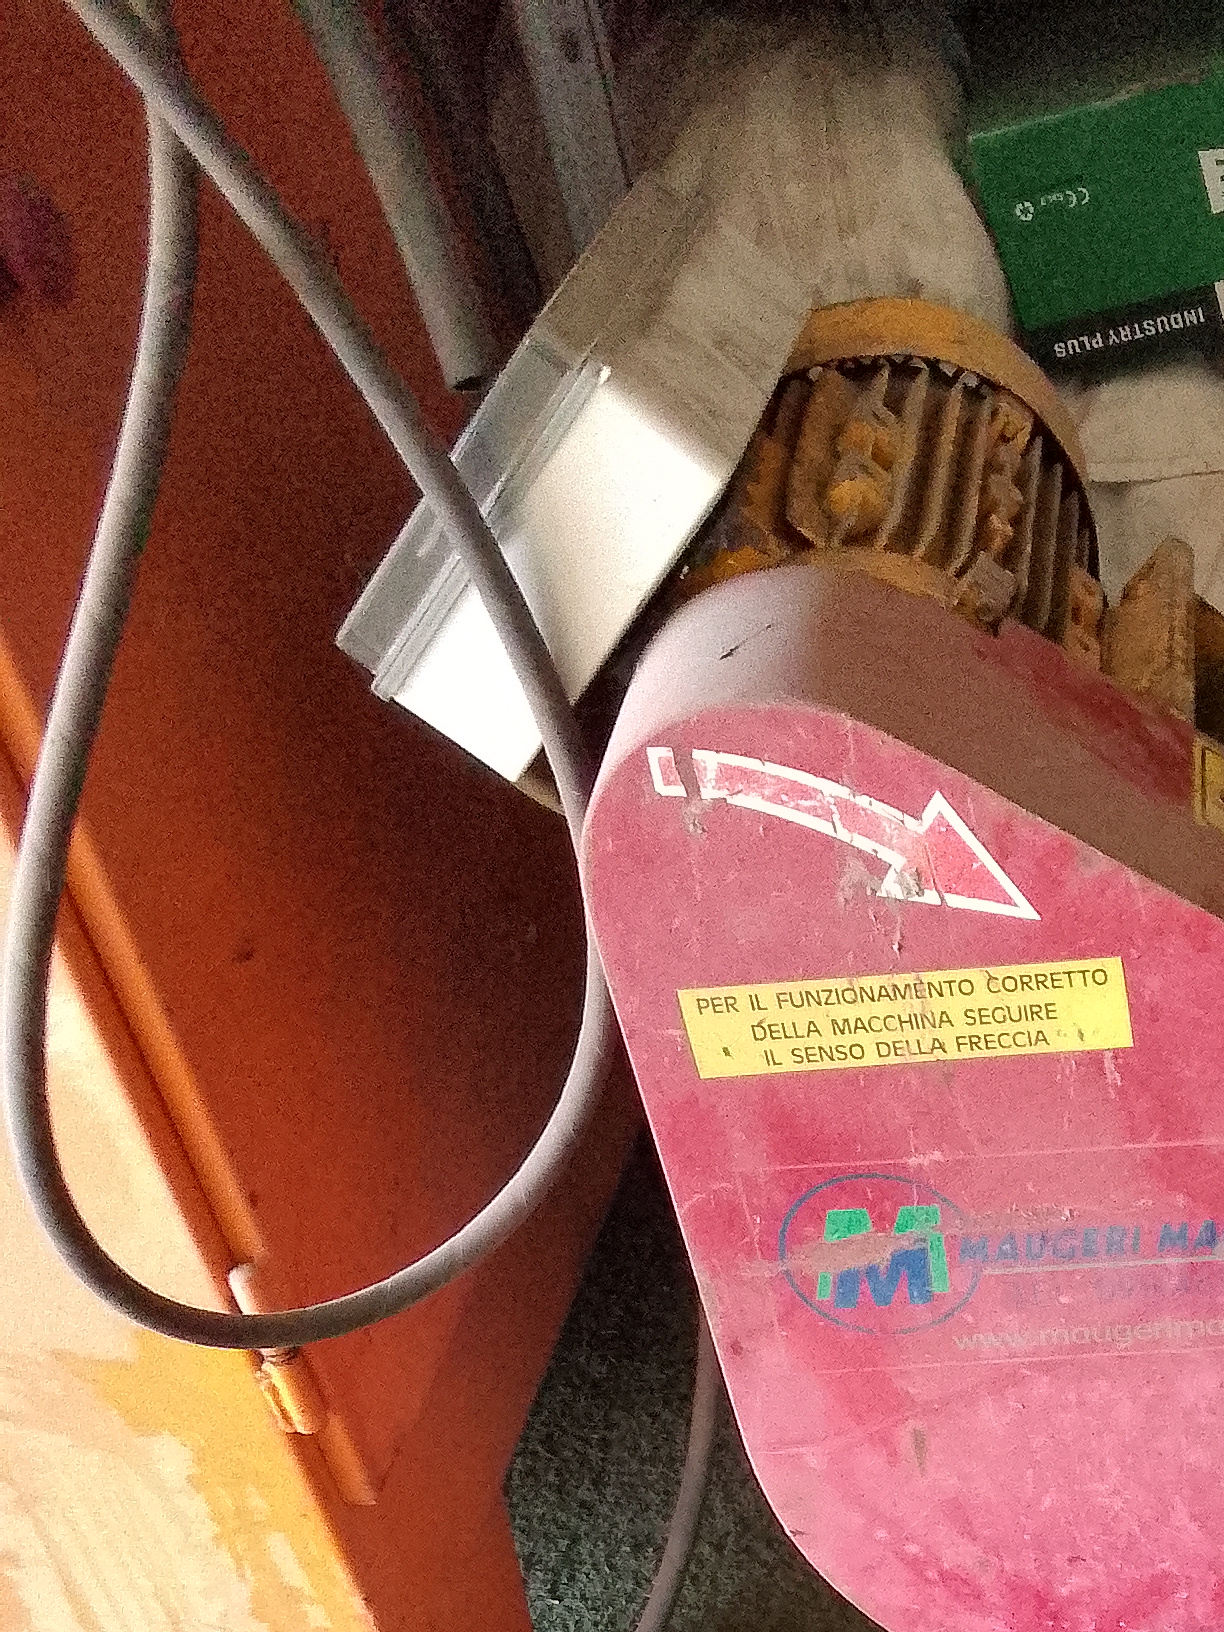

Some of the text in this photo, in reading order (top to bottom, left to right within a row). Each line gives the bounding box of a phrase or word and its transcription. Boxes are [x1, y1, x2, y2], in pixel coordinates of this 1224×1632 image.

[1053, 306, 1206, 358] INDUSTRY PLUS
[695, 967, 1109, 1016] PER IL FUNZIONAMENTO CORRETTO
[751, 1002, 1059, 1042] DELLA MACCHINA SEGUIRE
[763, 1029, 1051, 1067] IL SENSO DELLA FRECCIA
[959, 1223, 1142, 1265] MAUGERI
